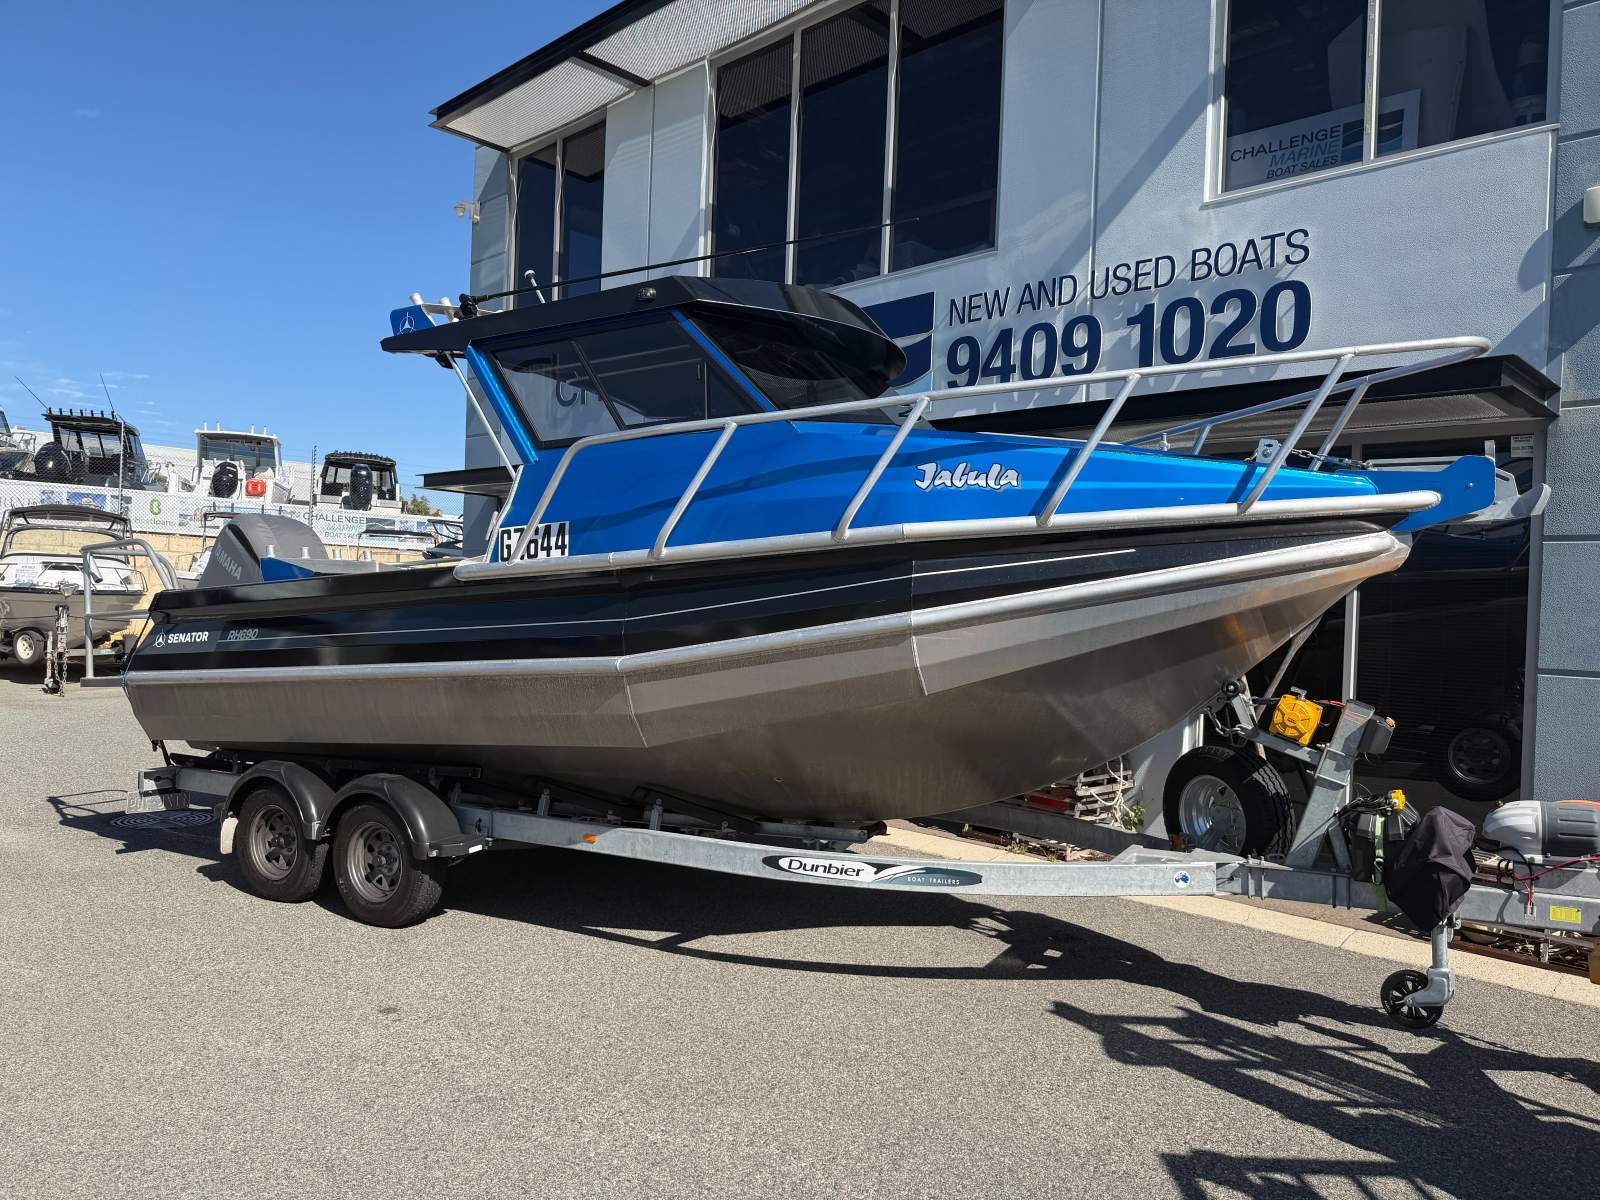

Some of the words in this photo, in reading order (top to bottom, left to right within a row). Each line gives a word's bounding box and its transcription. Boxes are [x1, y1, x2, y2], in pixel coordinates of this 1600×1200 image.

[1230, 124, 1341, 162] CHALLENGE
[1270, 141, 1339, 168] MARINE
[1266, 164, 1297, 179] BOAT
[1300, 155, 1338, 172] SALES
[949, 286, 1011, 326] NEW
[1017, 274, 1078, 315] AND
[1091, 255, 1176, 300] USED
[1190, 228, 1311, 282] BOATS
[946, 315, 1102, 388] 9409
[1126, 280, 1313, 367] 1020
[914, 462, 1020, 490] Jabula
[303, 512, 365, 524] CHALLENGE
[168, 632, 209, 644] SENATOR
[227, 629, 258, 640] RH690
[788, 859, 865, 877] Dunbier
[929, 877, 960, 885] TRAILERS
